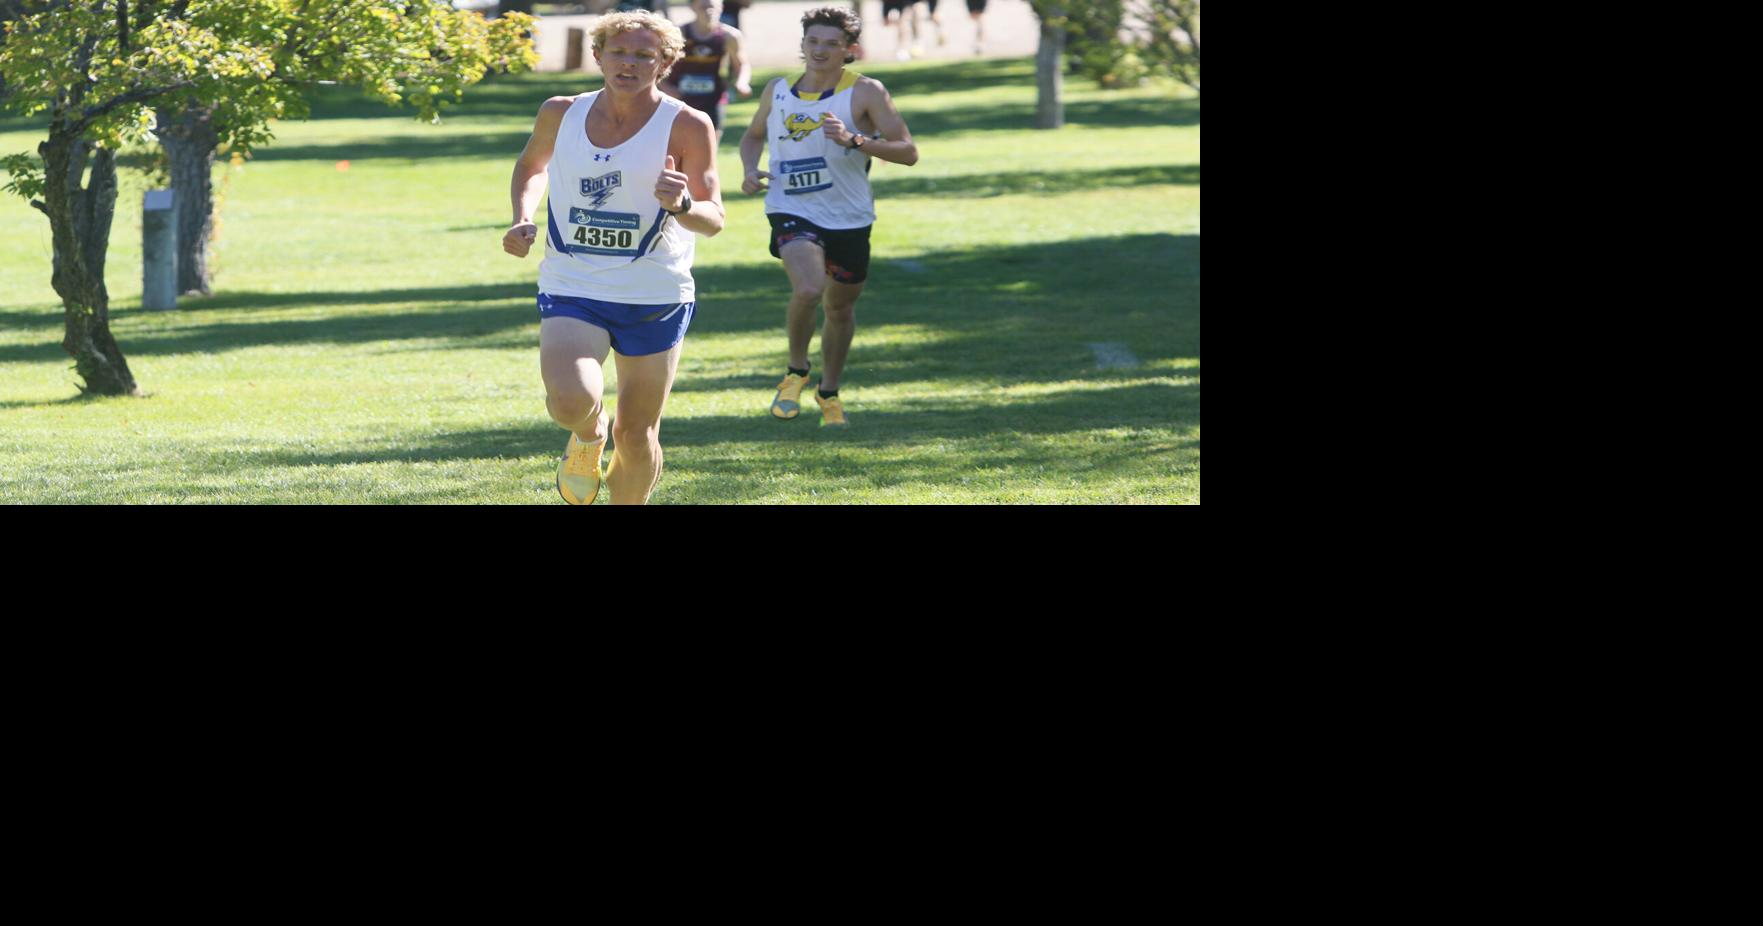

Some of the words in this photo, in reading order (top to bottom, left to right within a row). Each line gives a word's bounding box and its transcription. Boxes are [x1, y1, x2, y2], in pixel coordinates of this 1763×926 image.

[581, 174, 619, 193] BOLTS
[788, 171, 820, 187] 4177
[574, 226, 632, 248] 4350
